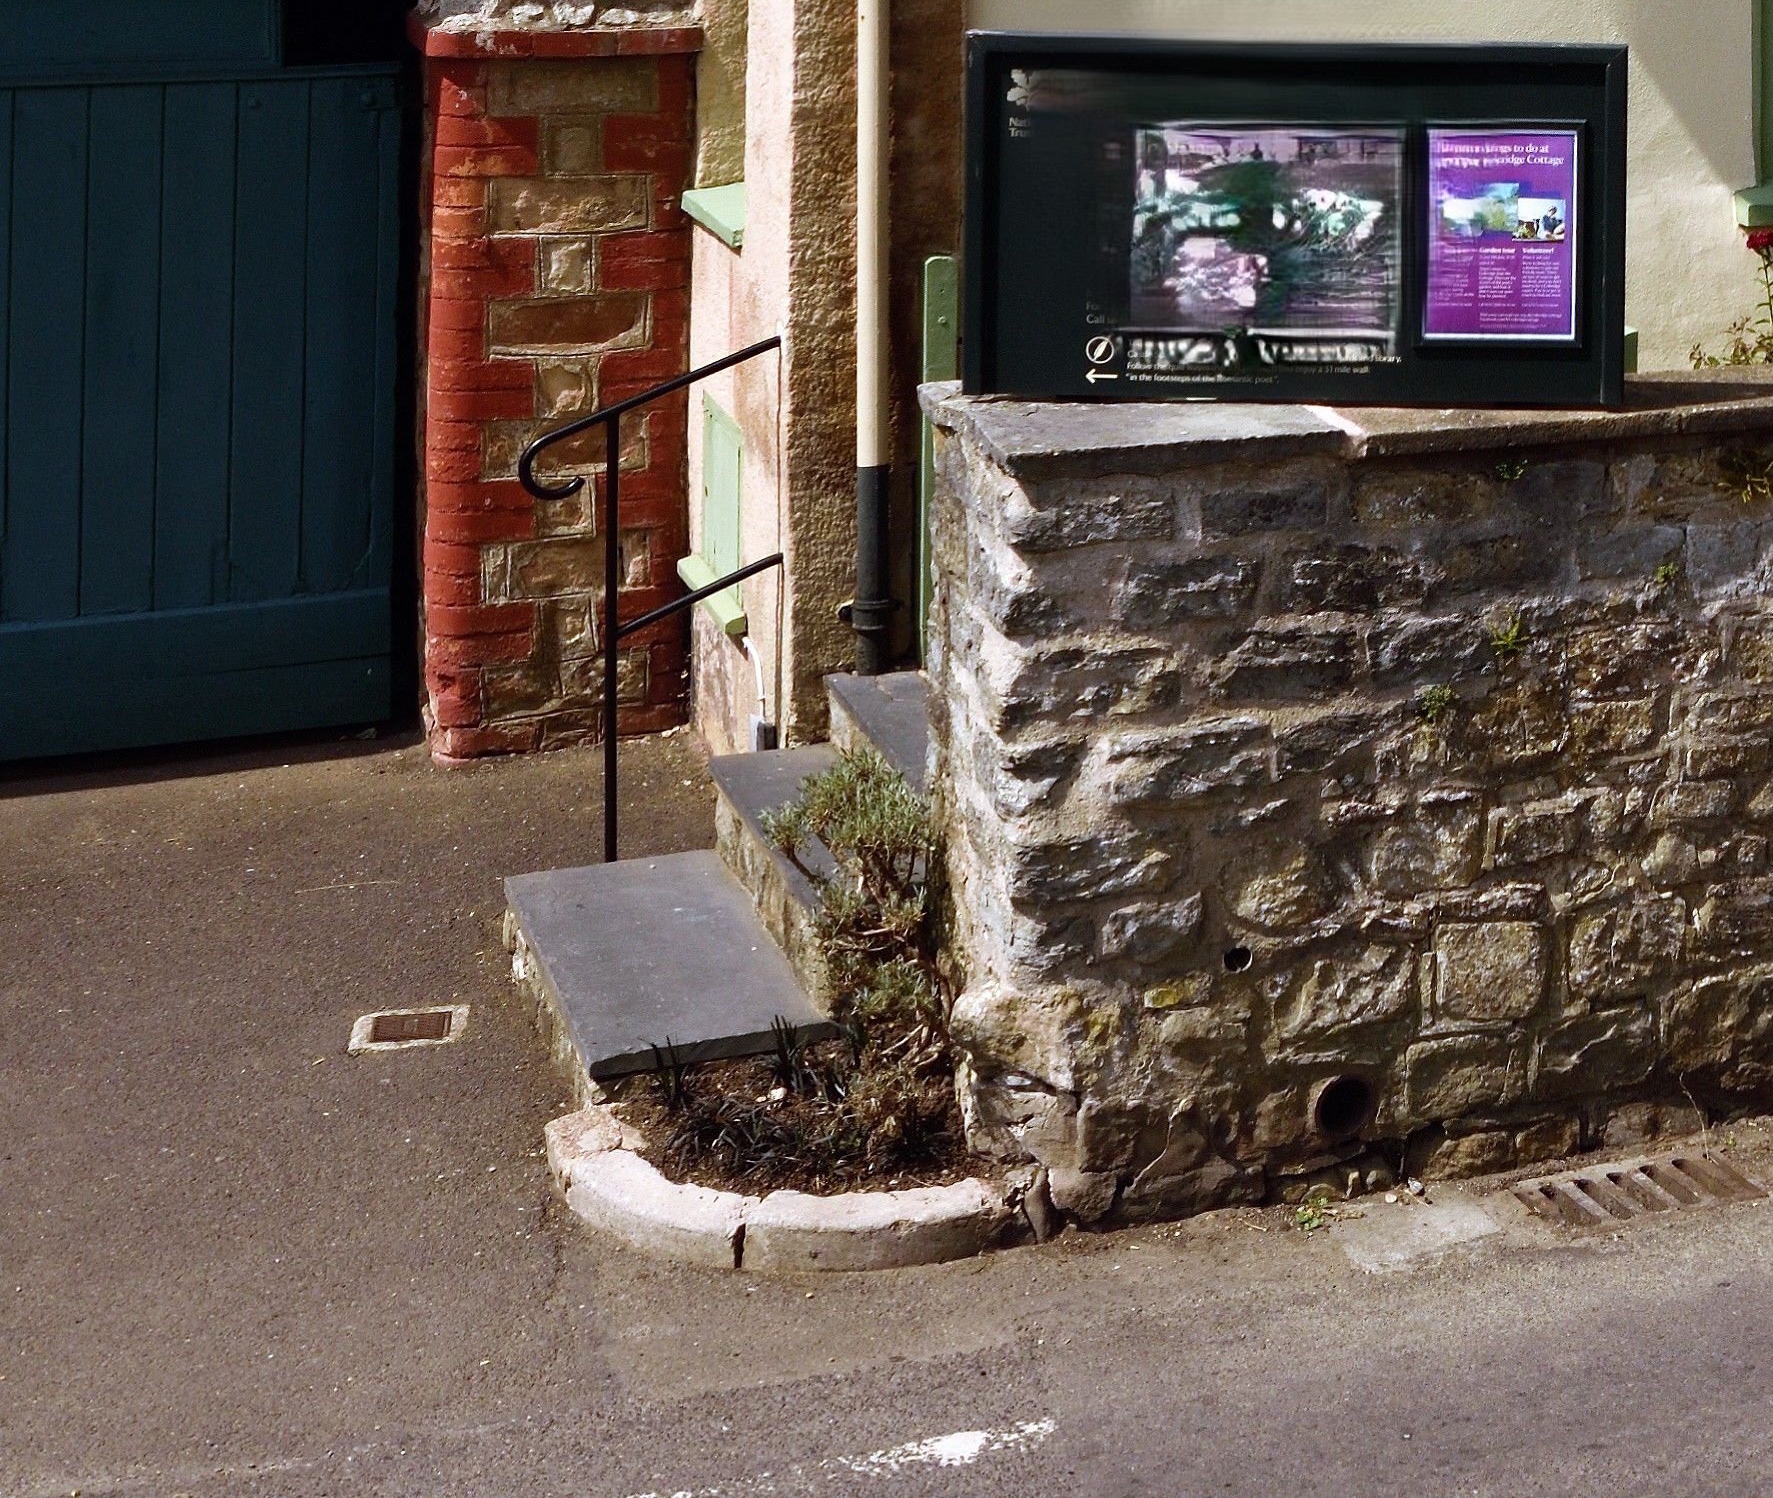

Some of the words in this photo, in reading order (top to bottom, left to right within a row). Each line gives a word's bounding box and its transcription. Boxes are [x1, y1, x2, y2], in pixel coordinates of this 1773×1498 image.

[1514, 144, 1524, 153] to
[1525, 143, 1538, 153] do
[1539, 144, 1549, 153] at
[1527, 154, 1565, 165] Cottage
[1086, 314, 1105, 324] Call
[1126, 361, 1151, 370] Follow
[1139, 373, 1153, 382] the
[1154, 373, 1190, 383] footsteps
[1191, 373, 1201, 382] of
[1202, 373, 1216, 382] the
